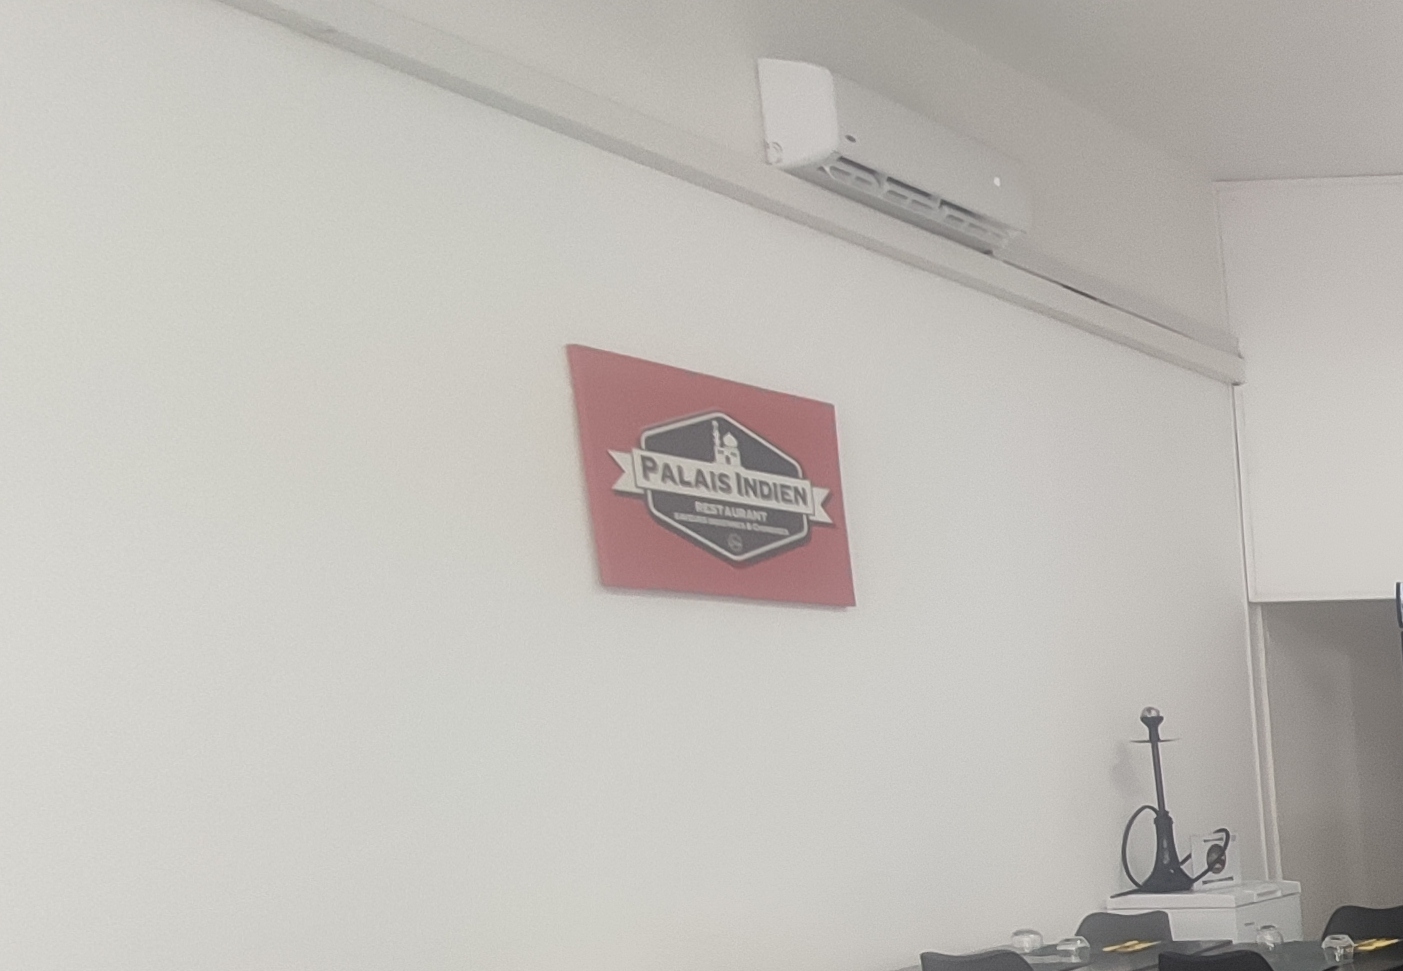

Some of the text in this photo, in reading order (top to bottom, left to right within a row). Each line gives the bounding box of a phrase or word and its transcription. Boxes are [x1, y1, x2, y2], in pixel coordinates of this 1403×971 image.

[640, 454, 809, 507] PALAIS INDIEN
[695, 500, 768, 523] RESTAURANT
